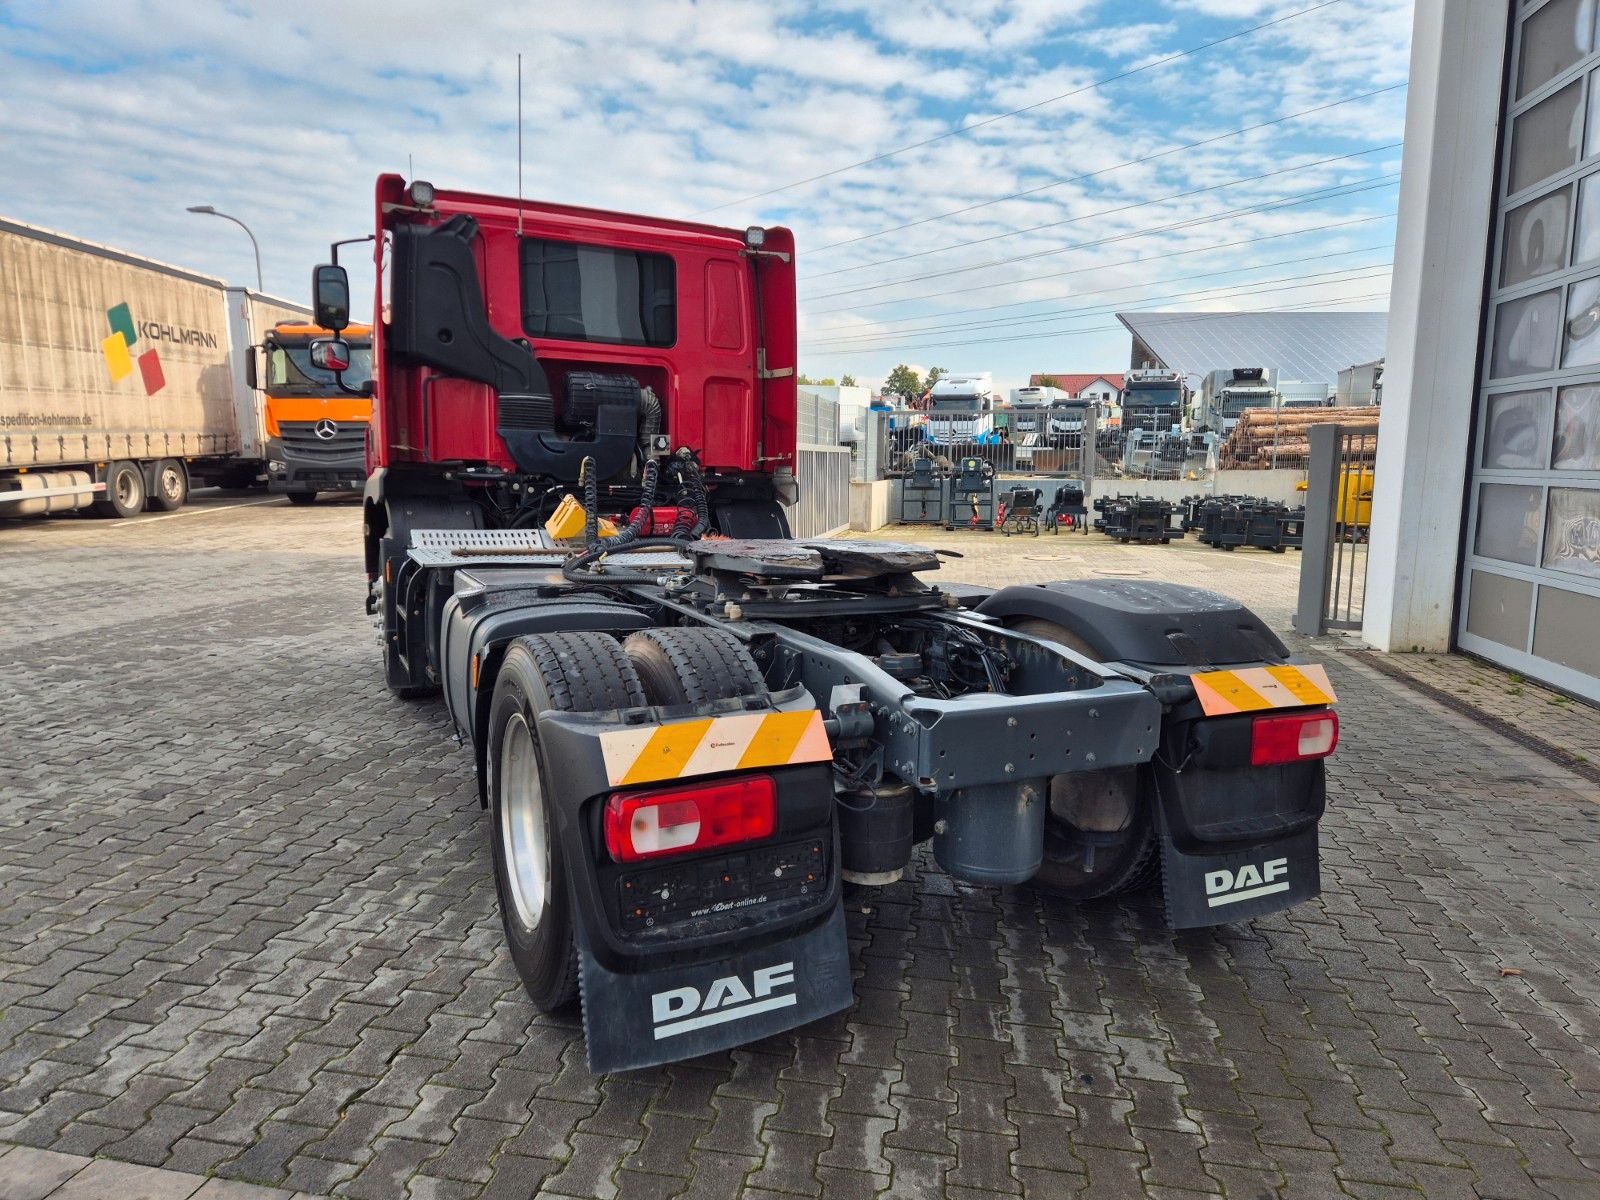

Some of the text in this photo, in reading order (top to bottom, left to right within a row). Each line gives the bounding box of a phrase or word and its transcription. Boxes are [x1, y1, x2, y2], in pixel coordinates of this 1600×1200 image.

[138, 321, 217, 349] KOHLMANN
[1205, 857, 1288, 895] DAF
[652, 962, 794, 1023] DAF
